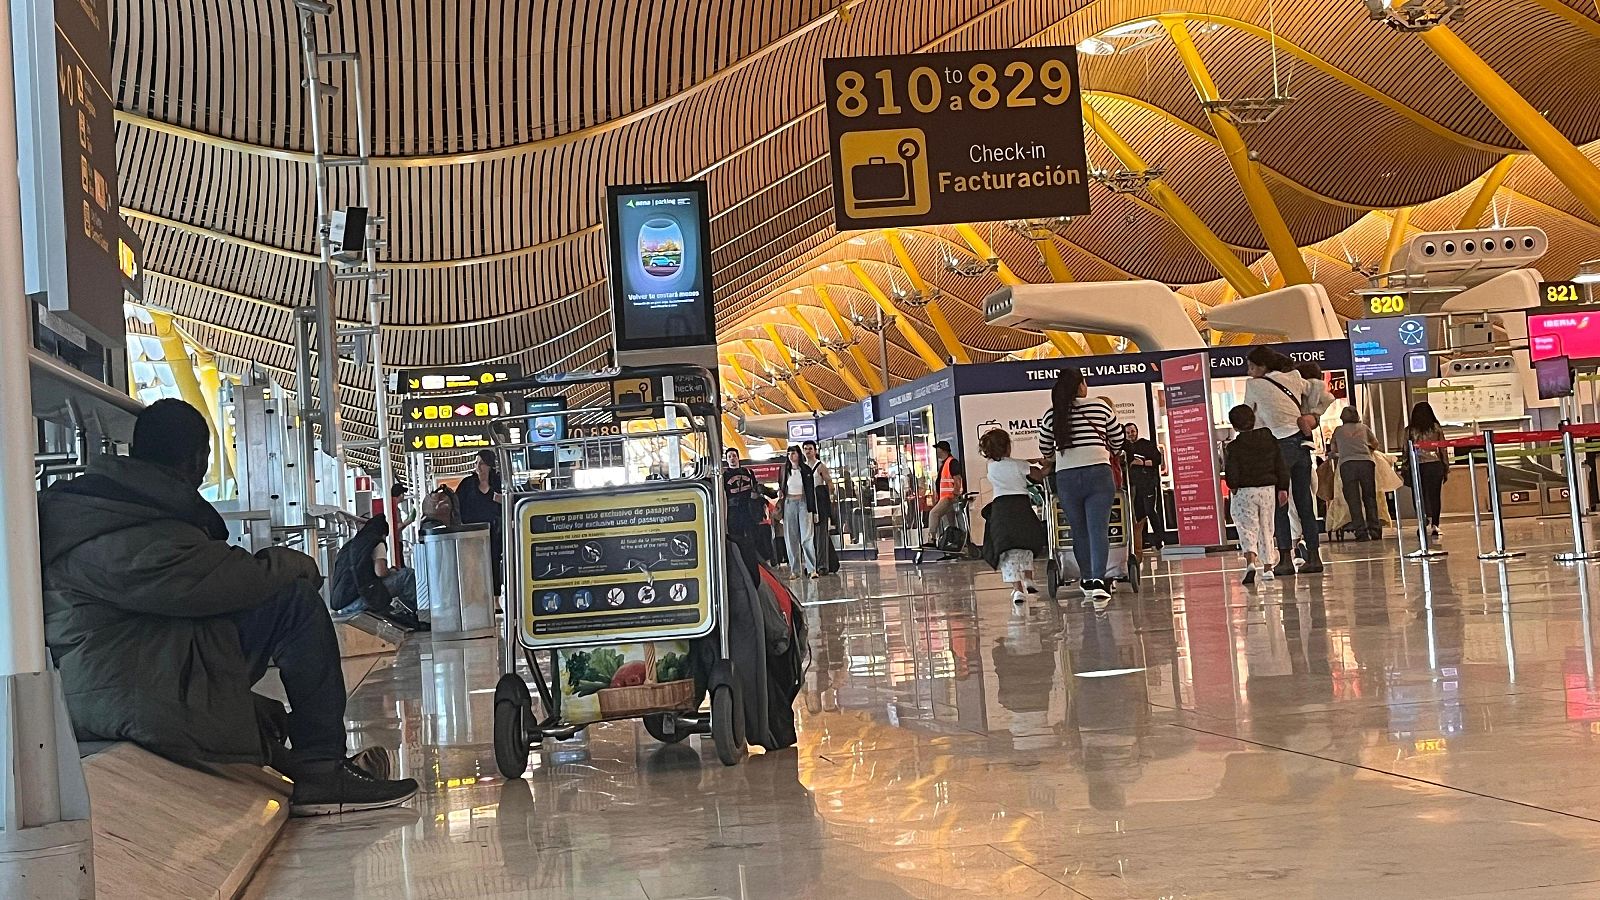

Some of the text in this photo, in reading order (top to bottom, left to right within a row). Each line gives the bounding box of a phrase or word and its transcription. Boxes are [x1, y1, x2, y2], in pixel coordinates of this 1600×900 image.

[835, 59, 1072, 117] 810 to a 829
[969, 142, 1045, 163] Check-in
[938, 165, 1081, 193] Facturación
[655, 198, 676, 206] parking
[656, 291, 678, 299] costará
[1547, 285, 1579, 302] 821
[1370, 295, 1405, 313] 820
[1543, 319, 1577, 328] IBERIA
[1209, 351, 1326, 368] E AND STORE
[1026, 363, 1147, 380] TIEND EL VIAJERO
[1008, 418, 1044, 430] MALE
[546, 515, 566, 523] Carro
[568, 514, 584, 522] para
[600, 509, 632, 518] exclusivo
[645, 505, 680, 516] pasajeros
[552, 522, 574, 531] Trolley
[585, 519, 615, 528] exclusive
[630, 516, 636, 524] of
